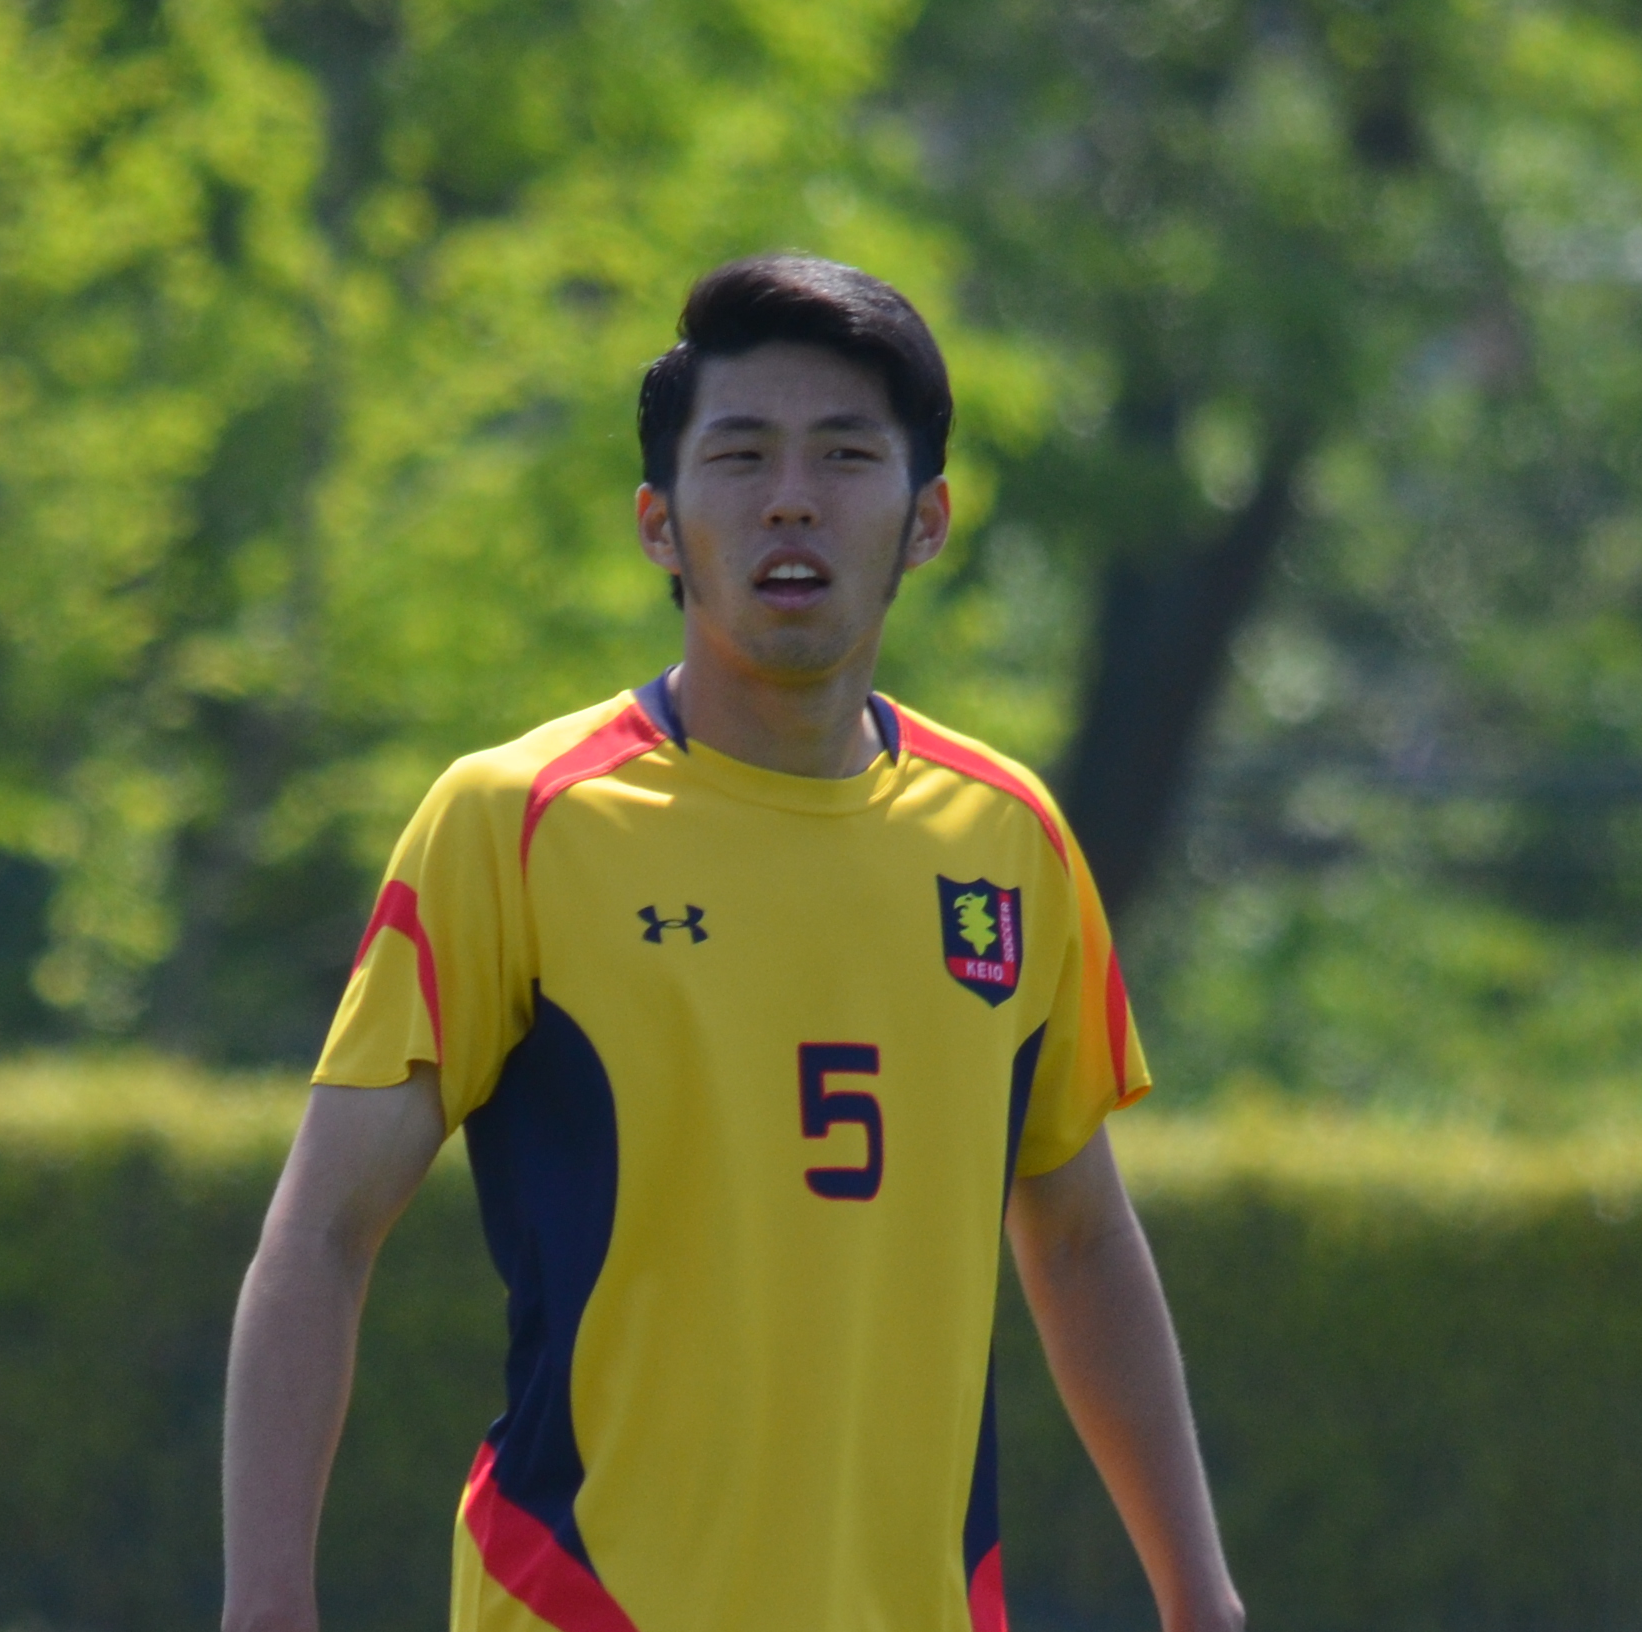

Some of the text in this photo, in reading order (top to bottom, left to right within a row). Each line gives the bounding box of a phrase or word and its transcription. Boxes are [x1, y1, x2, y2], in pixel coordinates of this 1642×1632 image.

[1000, 901, 1015, 963] SOCCER
[966, 961, 1004, 982] KEIO
[797, 1041, 884, 1202] 5
